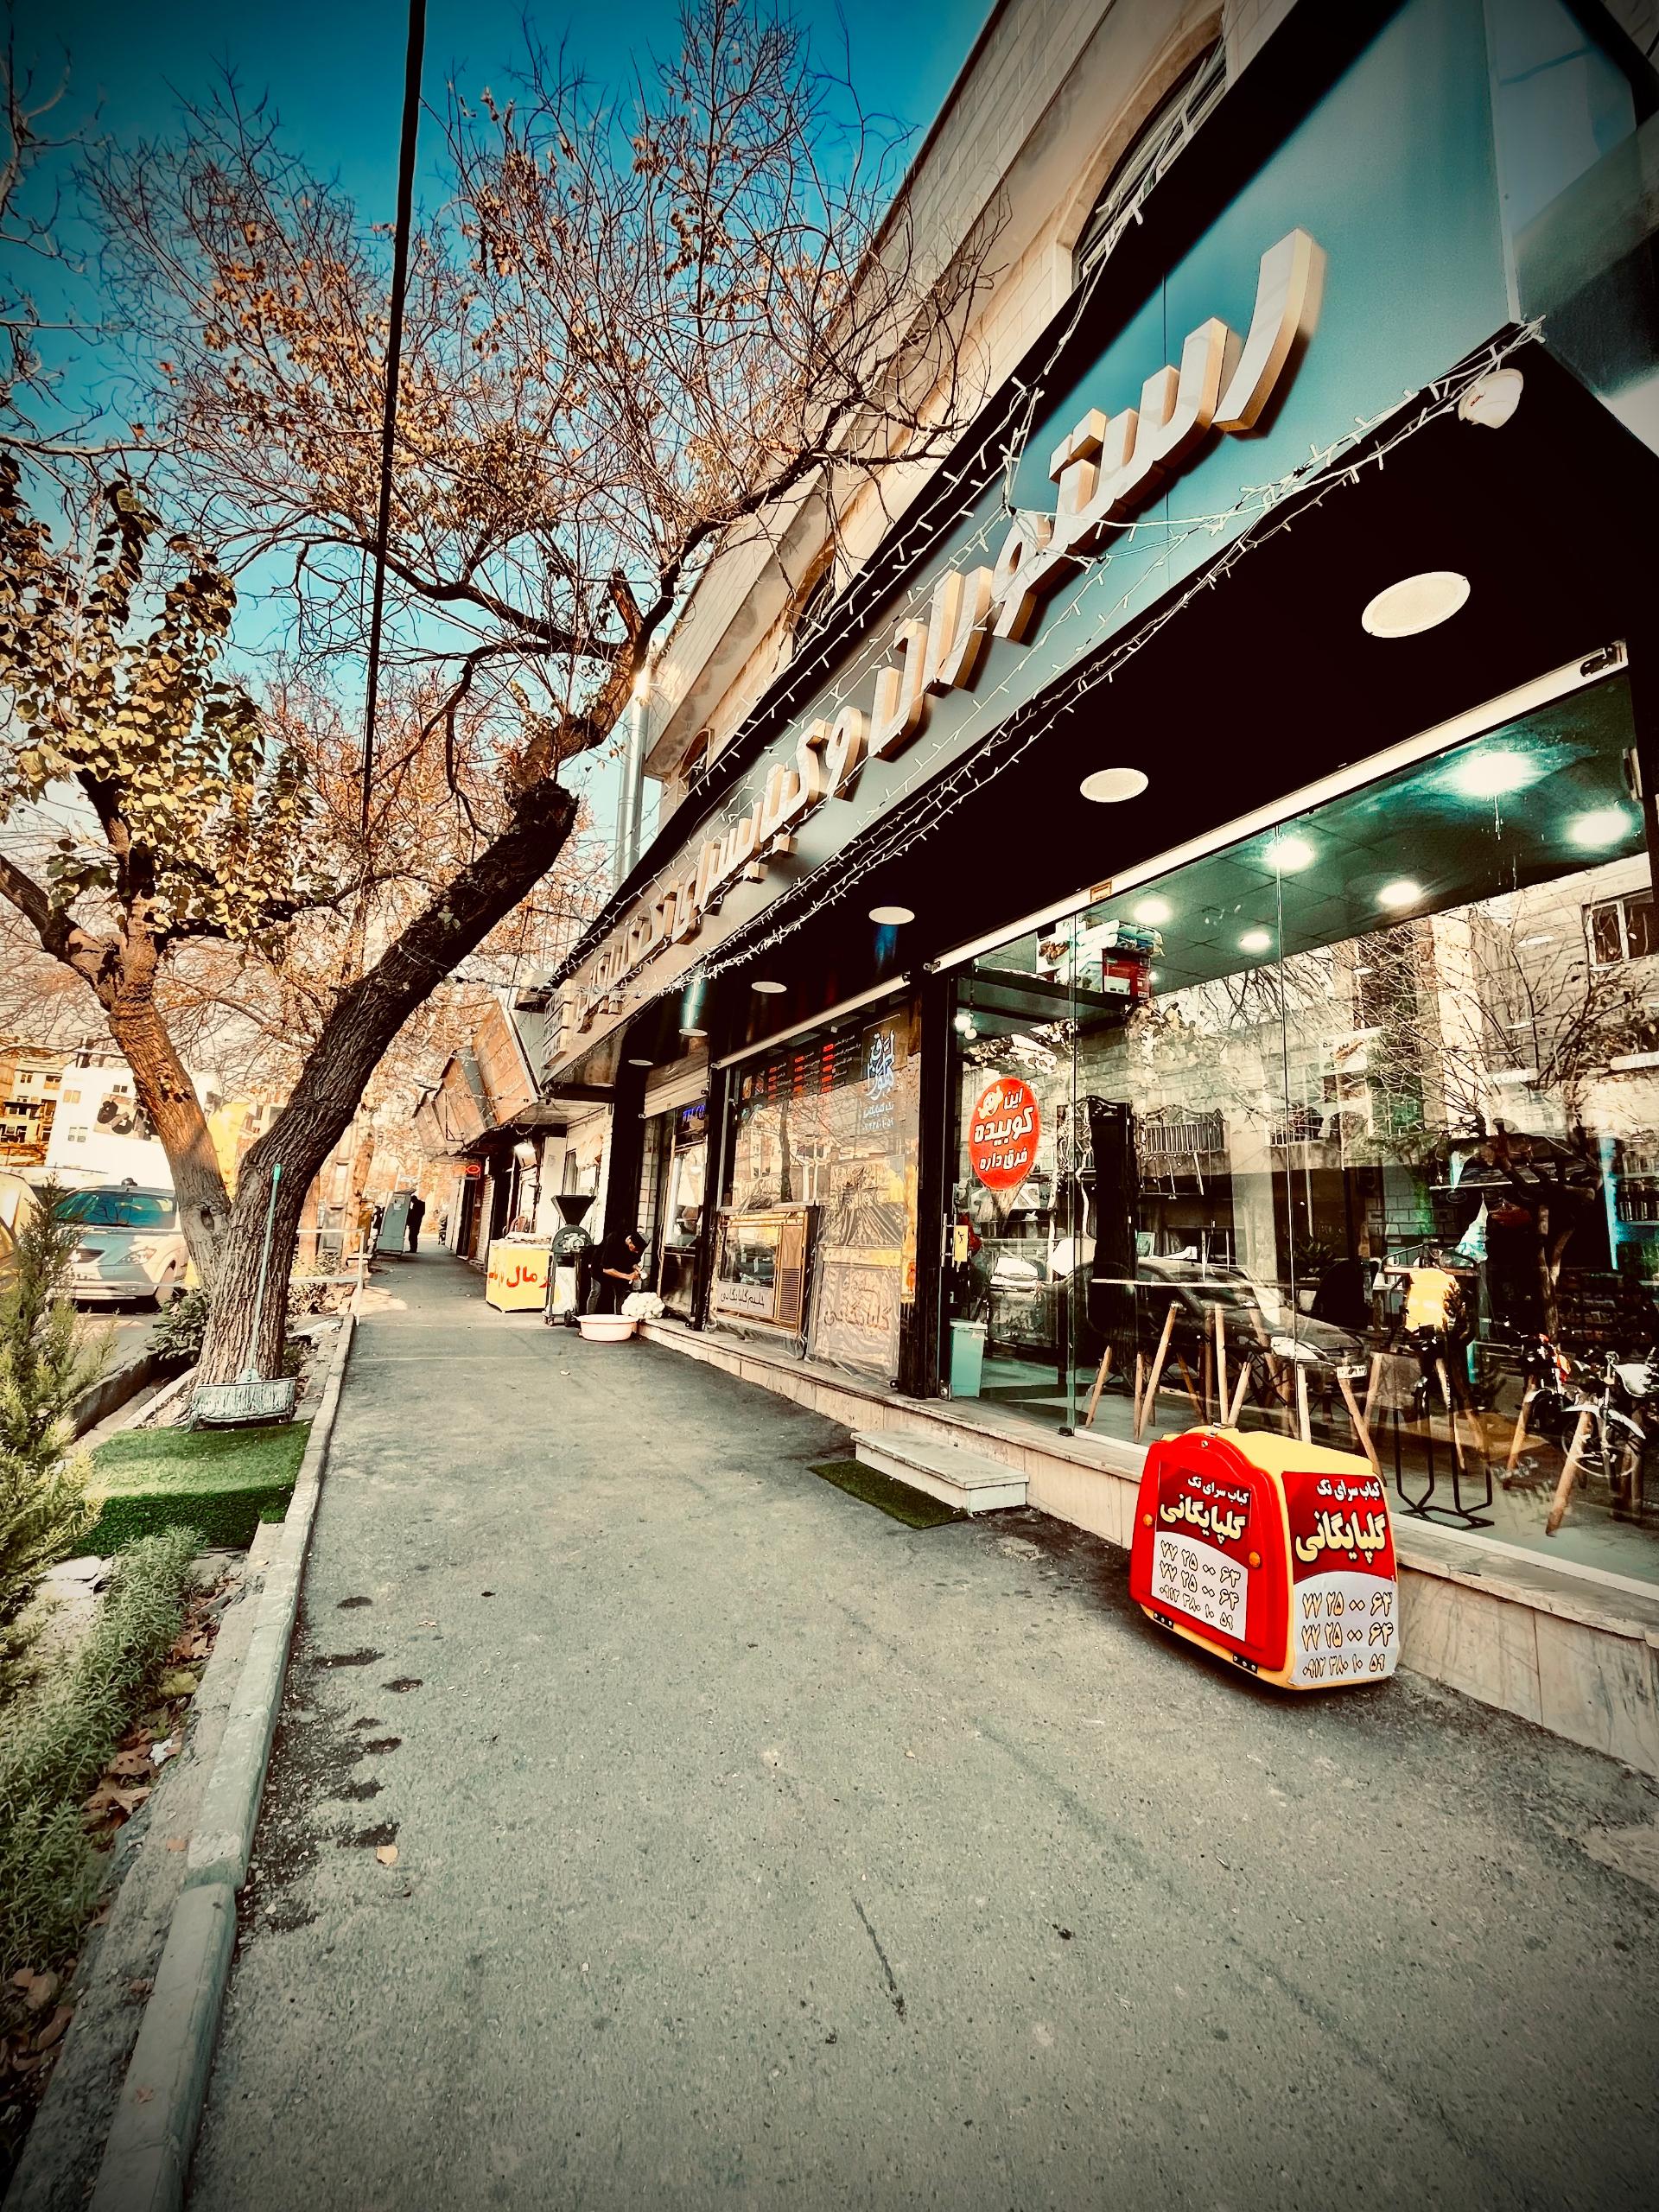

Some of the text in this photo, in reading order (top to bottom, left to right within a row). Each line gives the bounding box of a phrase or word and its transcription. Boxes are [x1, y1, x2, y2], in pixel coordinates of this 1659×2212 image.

[868, 227, 1325, 762] رستوران
[825, 705, 864, 800] و
[1003, 1087, 1024, 1109] این
[974, 1106, 1034, 1146] کوبیده
[979, 1147, 1028, 1172] فرق داره
[1188, 1477, 1202, 1488] تک
[1317, 1479, 1332, 1495] تک
[1359, 1481, 1380, 1500] کباب
[1228, 1490, 1249, 1505] کباب
[1160, 1494, 1245, 1544] گلپایگانی
[1296, 1510, 1386, 1564] گلپایگانی
